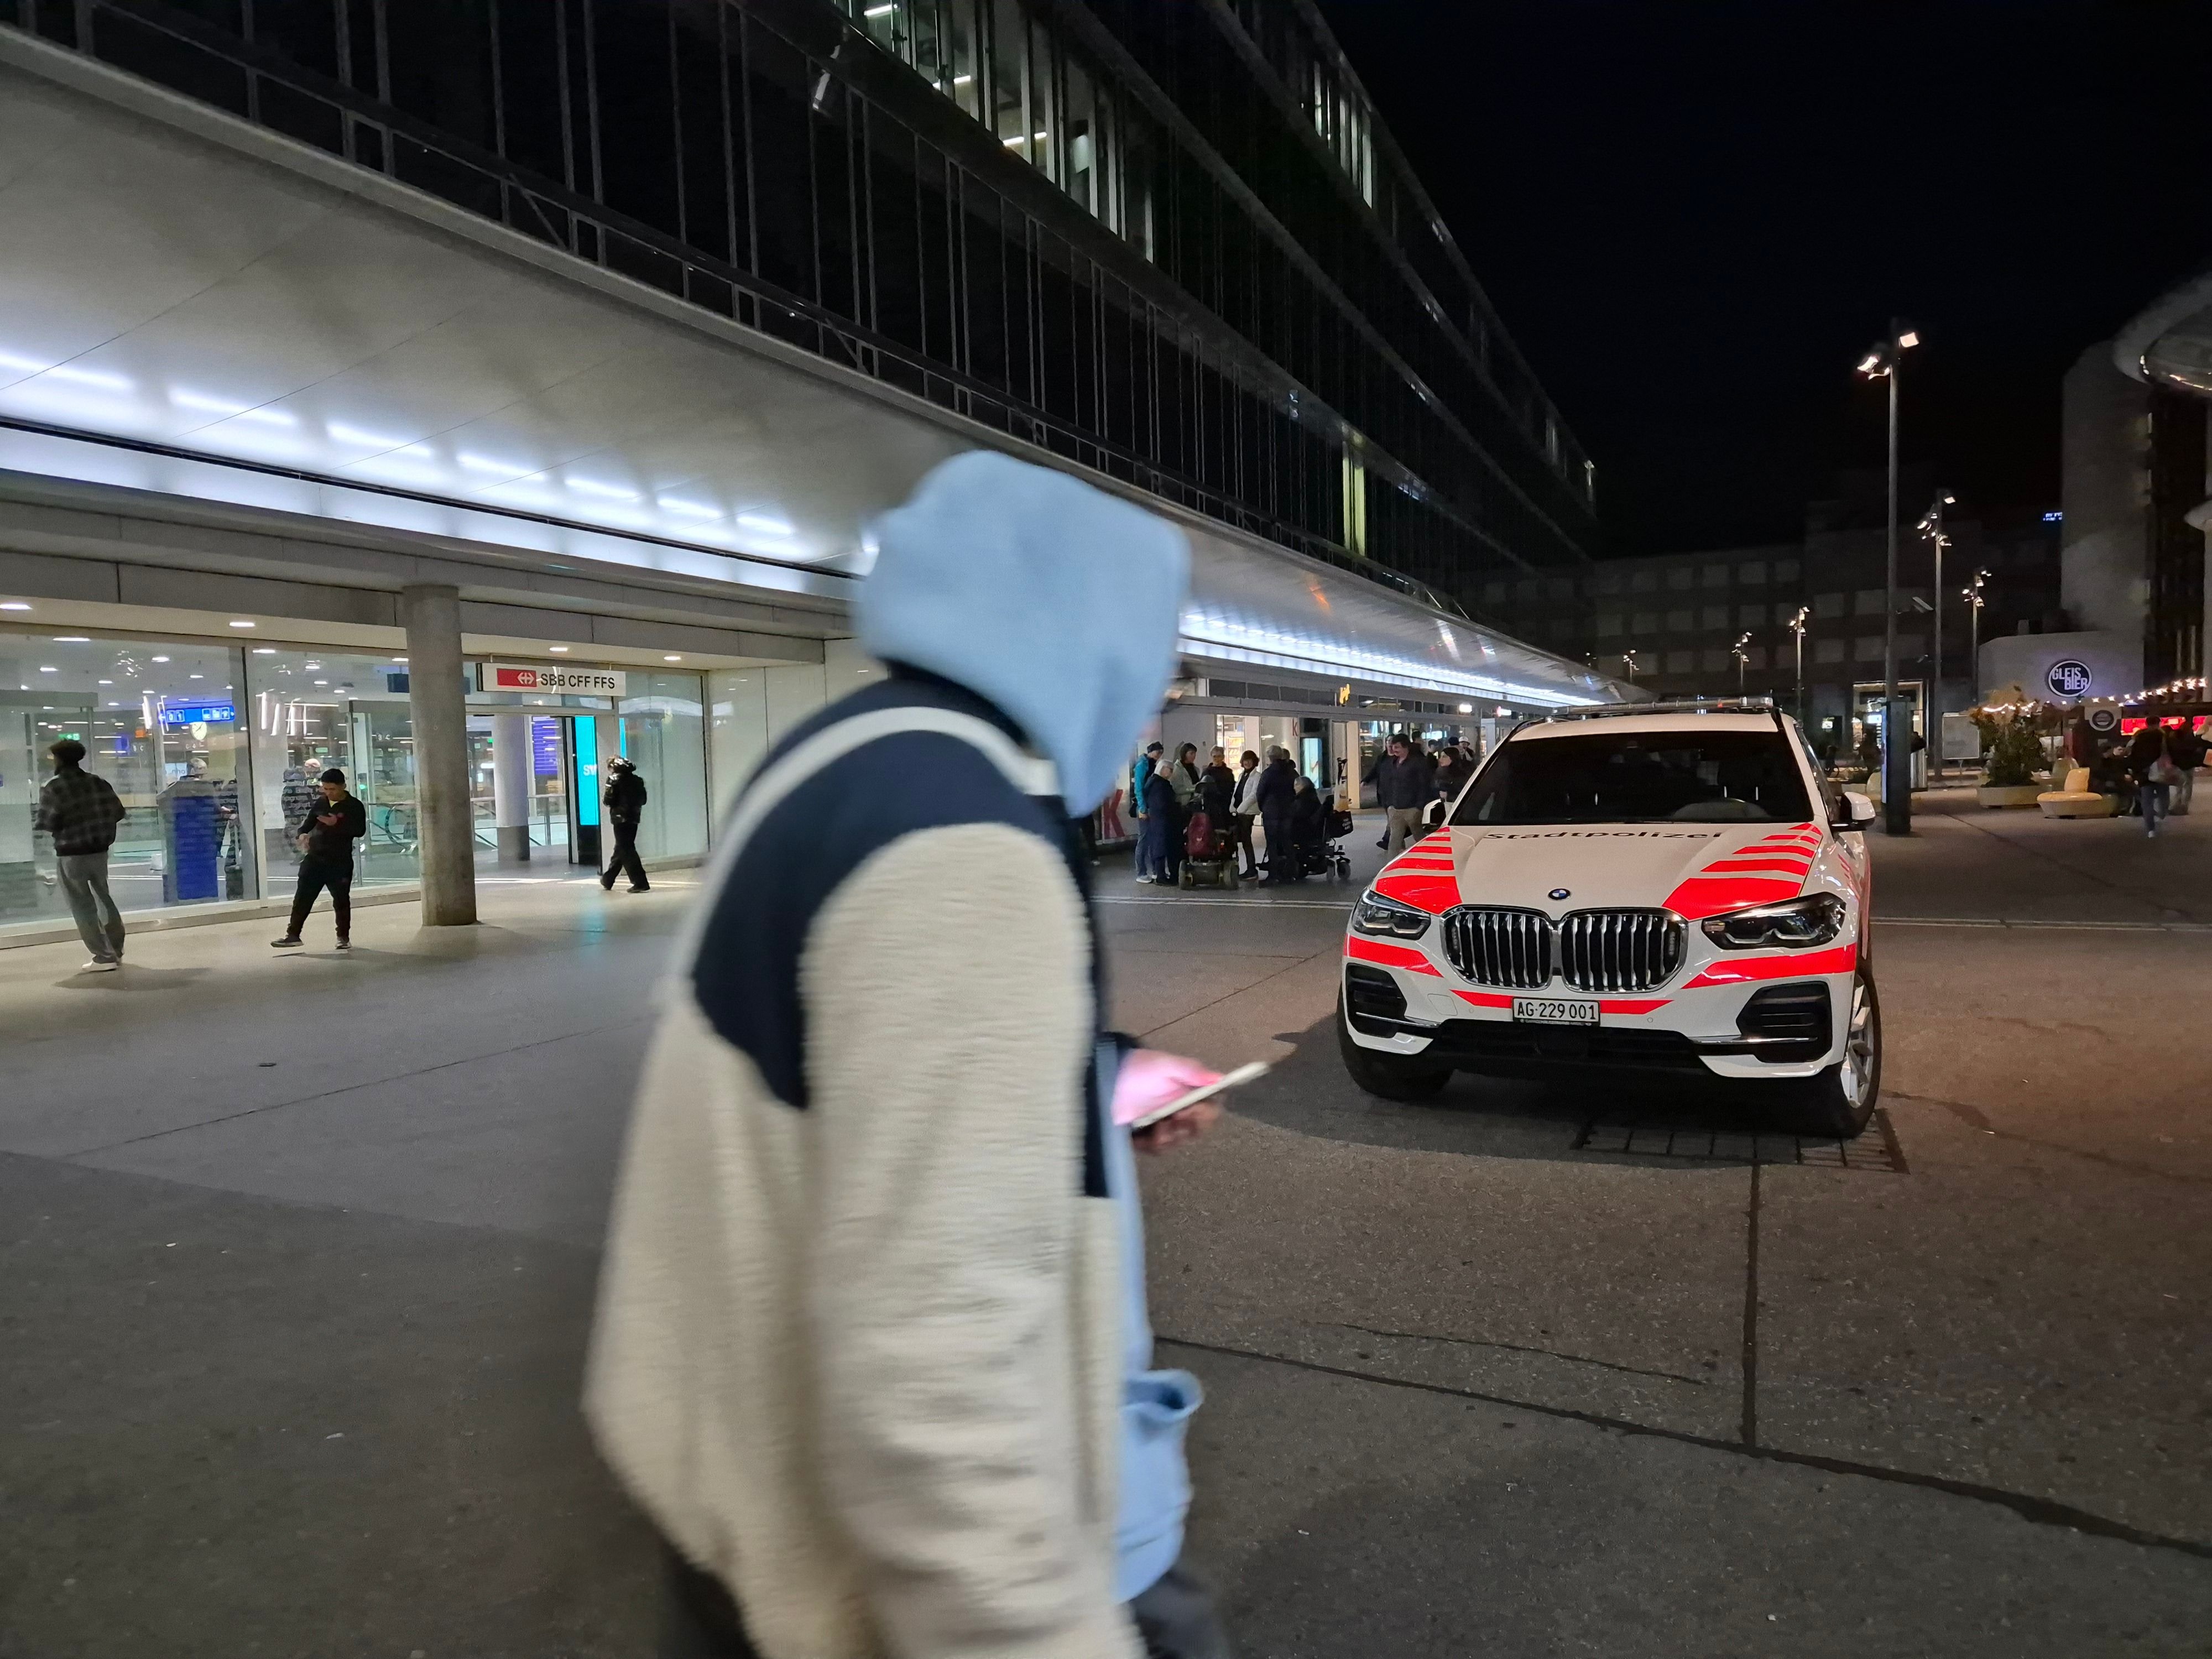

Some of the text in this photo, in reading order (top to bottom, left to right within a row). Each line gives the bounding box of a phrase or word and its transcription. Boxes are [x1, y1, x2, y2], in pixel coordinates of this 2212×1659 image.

[540, 673, 615, 688] SBB CFF FFS
[2052, 667, 2081, 680] GLEIS
[2064, 677, 2088, 690] BIER
[1569, 1004, 1596, 1020] 001
